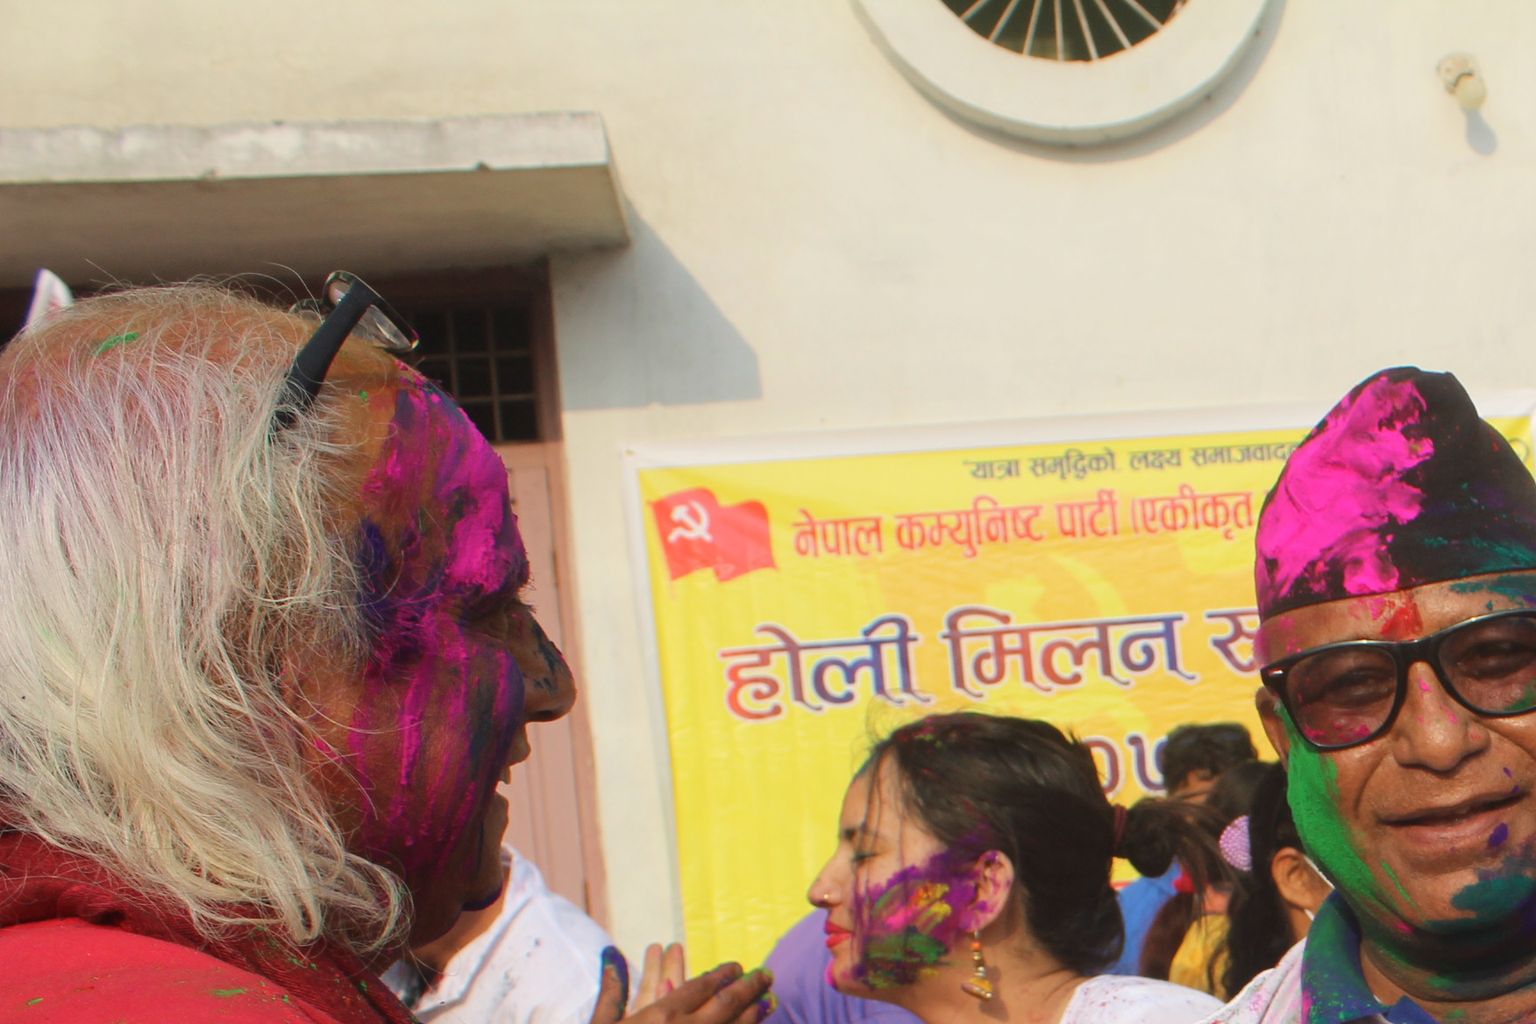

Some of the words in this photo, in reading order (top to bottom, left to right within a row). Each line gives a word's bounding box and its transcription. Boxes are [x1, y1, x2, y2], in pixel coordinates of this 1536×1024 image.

[1128, 449, 1182, 471] लक्ष्य
[792, 507, 883, 557] नेपाल
[894, 495, 1042, 558] कम्युनिष्ट
[1053, 488, 1119, 538] पार्टी
[719, 614, 934, 721] होली
[941, 604, 1198, 699] मिलन
